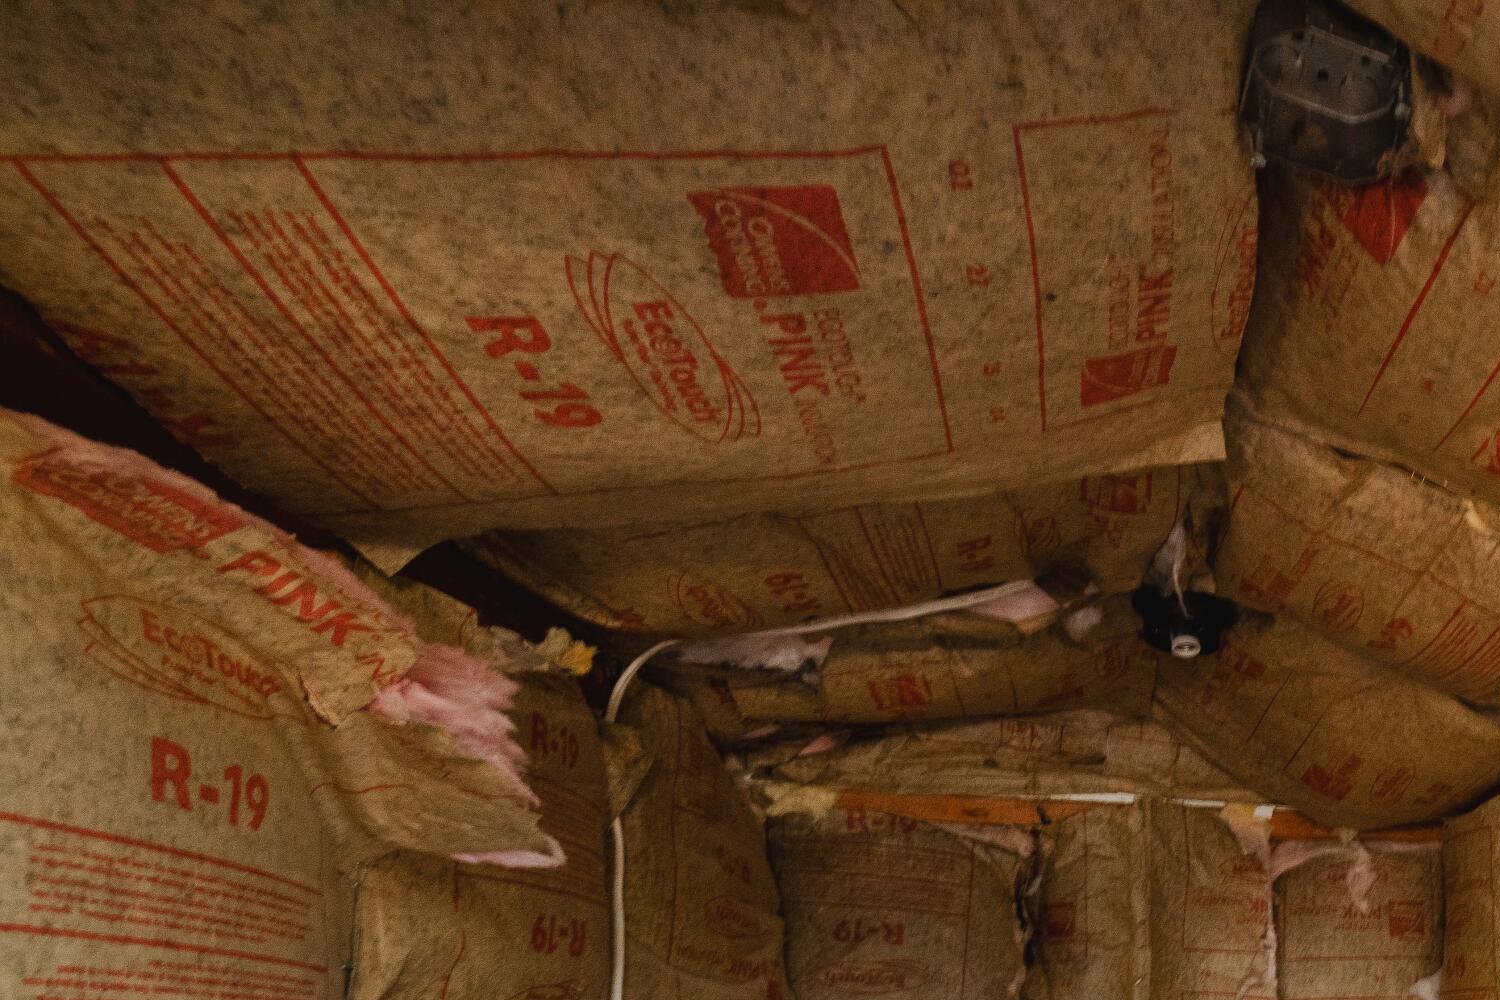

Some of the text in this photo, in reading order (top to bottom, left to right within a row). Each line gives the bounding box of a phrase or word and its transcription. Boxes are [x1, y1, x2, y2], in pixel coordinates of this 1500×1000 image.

[1136, 263, 1174, 343] PINK
[464, 314, 603, 429] R-19
[632, 301, 722, 426] EcoTouch
[760, 314, 830, 395] PINK
[216, 550, 376, 647] PINK
[140, 606, 282, 699] EcoTouch
[151, 735, 270, 831] R-19
[531, 911, 587, 958] R-19
[832, 918, 905, 946] R-19
